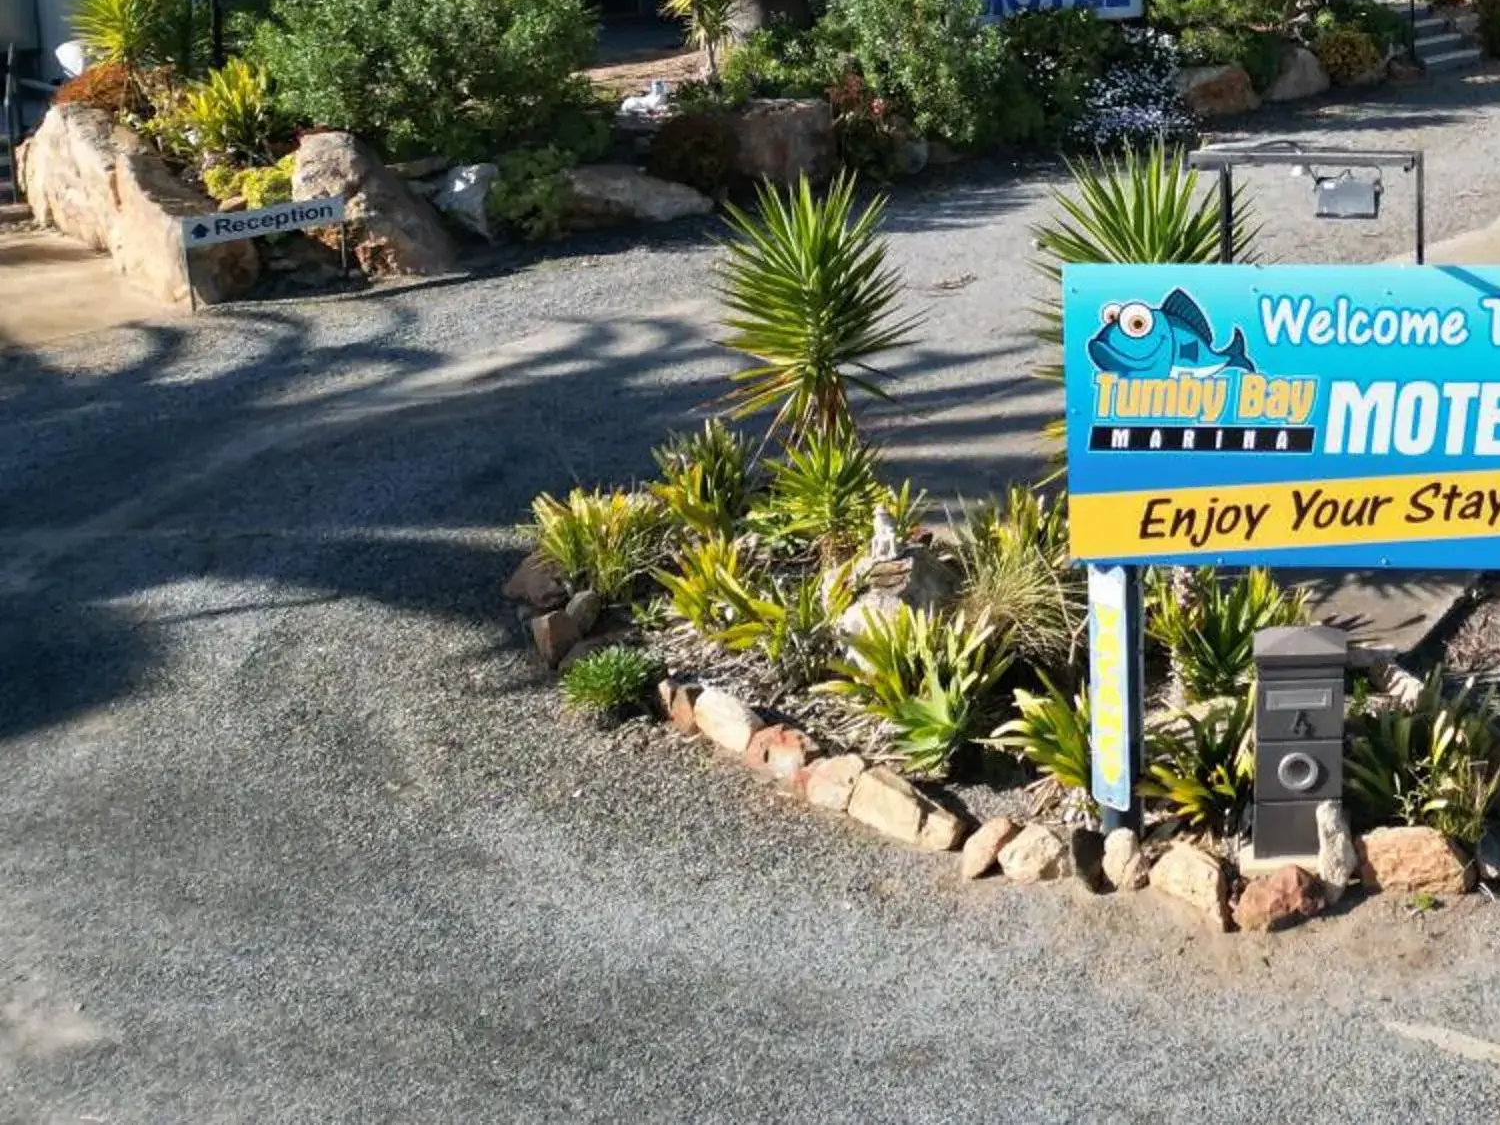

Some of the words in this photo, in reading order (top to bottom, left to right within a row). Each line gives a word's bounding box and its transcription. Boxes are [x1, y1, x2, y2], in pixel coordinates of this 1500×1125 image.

[214, 204, 333, 236] Reception
[1260, 296, 1469, 347] Welcome
[1095, 373, 1227, 424] Tumby
[1238, 374, 1316, 424] Bay
[1111, 428, 1289, 450] MARINA
[1139, 497, 1271, 548] Enjoy
[1291, 489, 1393, 531] Your
